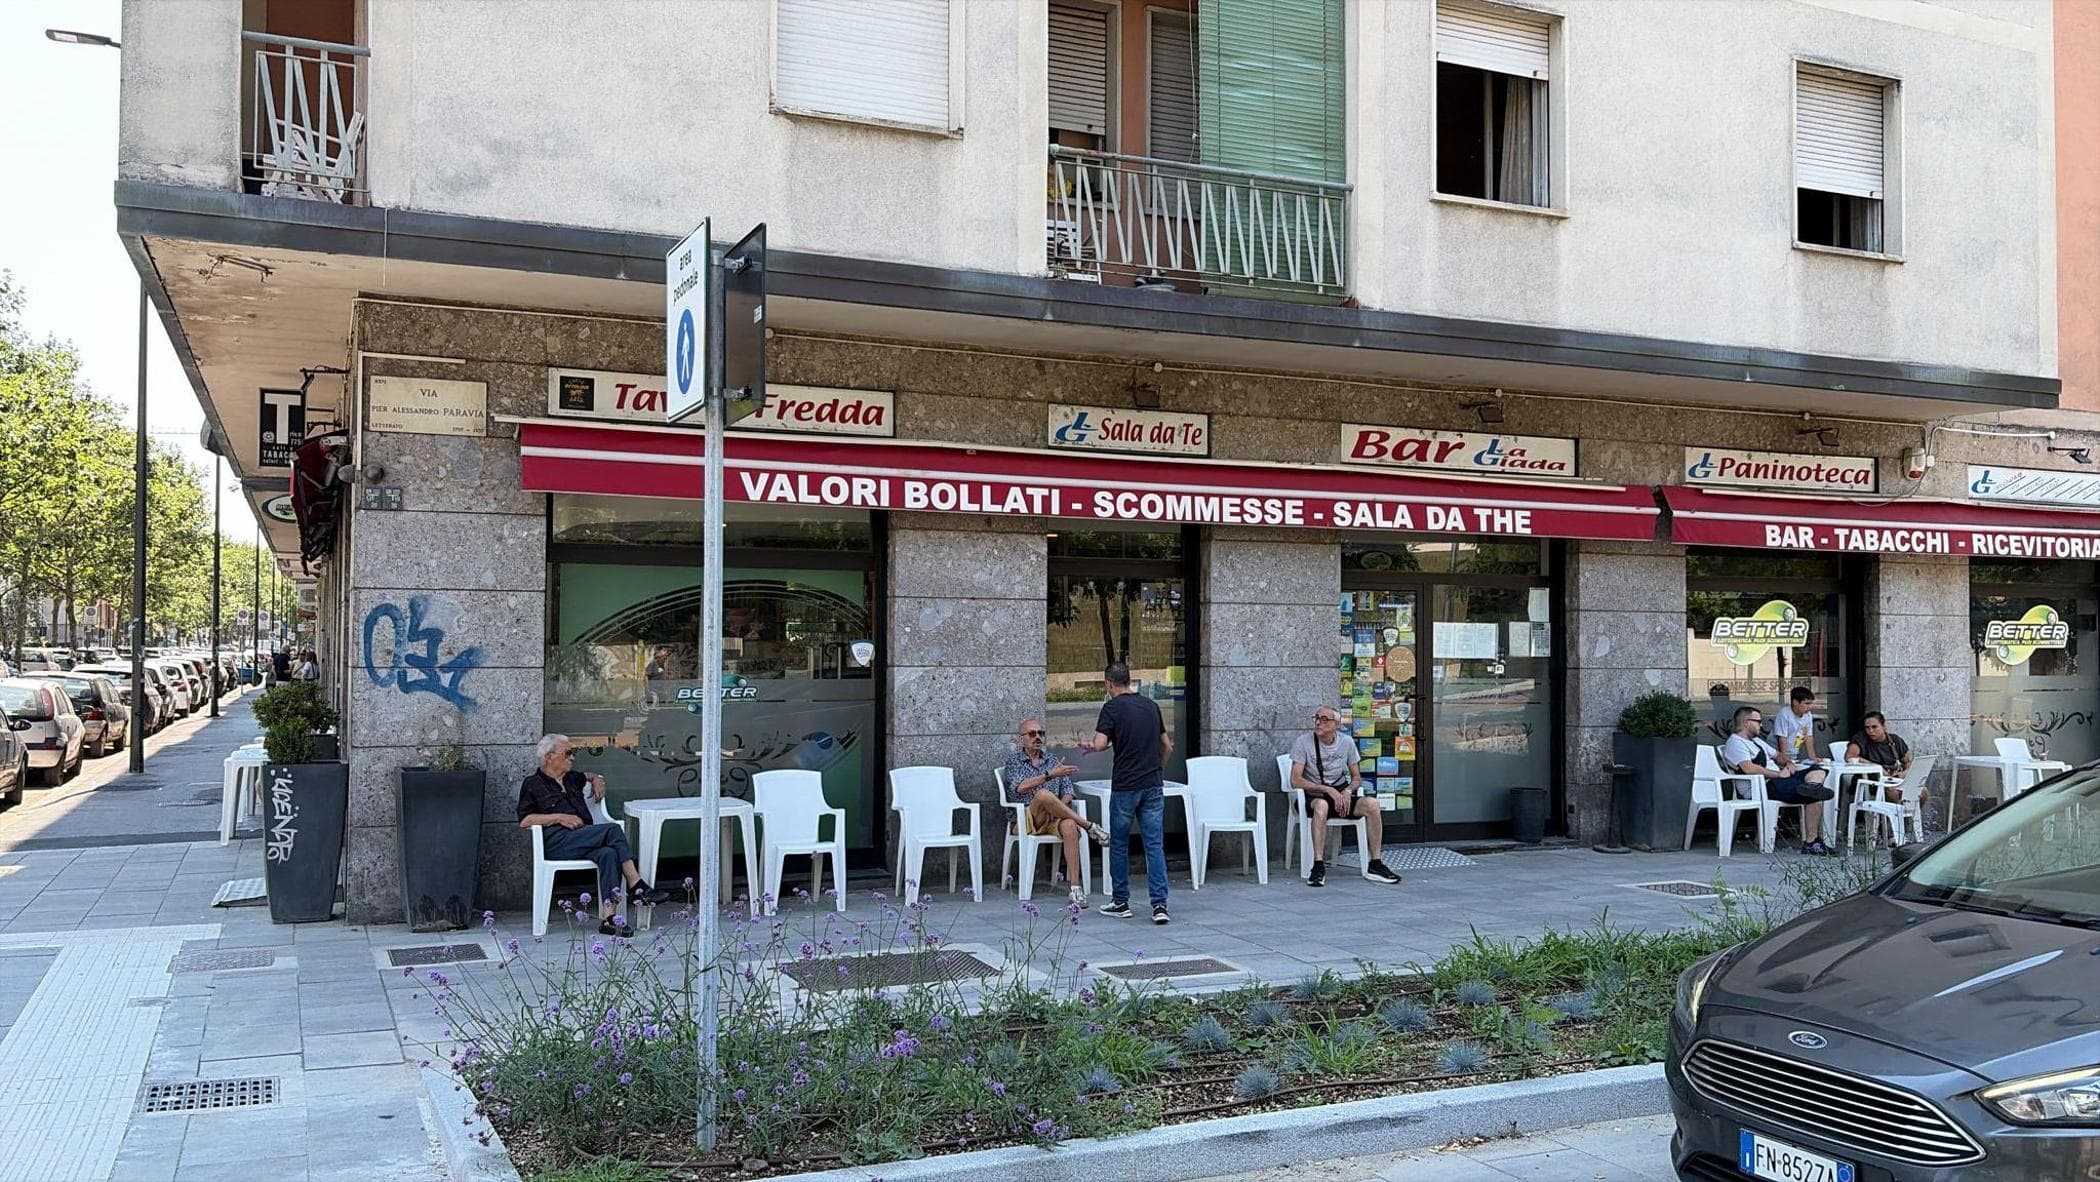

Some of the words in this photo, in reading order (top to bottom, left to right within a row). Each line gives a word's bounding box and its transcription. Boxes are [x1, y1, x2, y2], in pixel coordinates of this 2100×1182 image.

[679, 250, 692, 271] area
[673, 268, 699, 306] pedonale
[420, 388, 438, 398] VIA
[371, 405, 388, 413] PIER
[392, 406, 439, 416] ALESSANDRO
[443, 408, 484, 418] PARAVIA
[755, 393, 884, 426] Fredda
[1098, 417, 1143, 442] Sala
[1150, 422, 1176, 445] da
[1182, 423, 1203, 446] Te
[1351, 430, 1466, 464] Bar
[1473, 449, 1566, 472] Giada
[1718, 457, 1871, 485] Paninoteca
[740, 472, 890, 507] VALORI
[904, 480, 1060, 515] BOLLATI
[1093, 491, 1304, 526] SCOMMESSE
[1333, 501, 1414, 530] SALA
[1427, 506, 1467, 532] DA
[1473, 508, 1532, 534] THE
[1765, 524, 1815, 549] BAR
[1834, 528, 1950, 554] TABACCHI
[1972, 532, 2100, 558] RICEVITORIA
[1715, 621, 1806, 637] BETTER
[1988, 624, 2066, 639] BETTER
[677, 687, 758, 699] BETER
